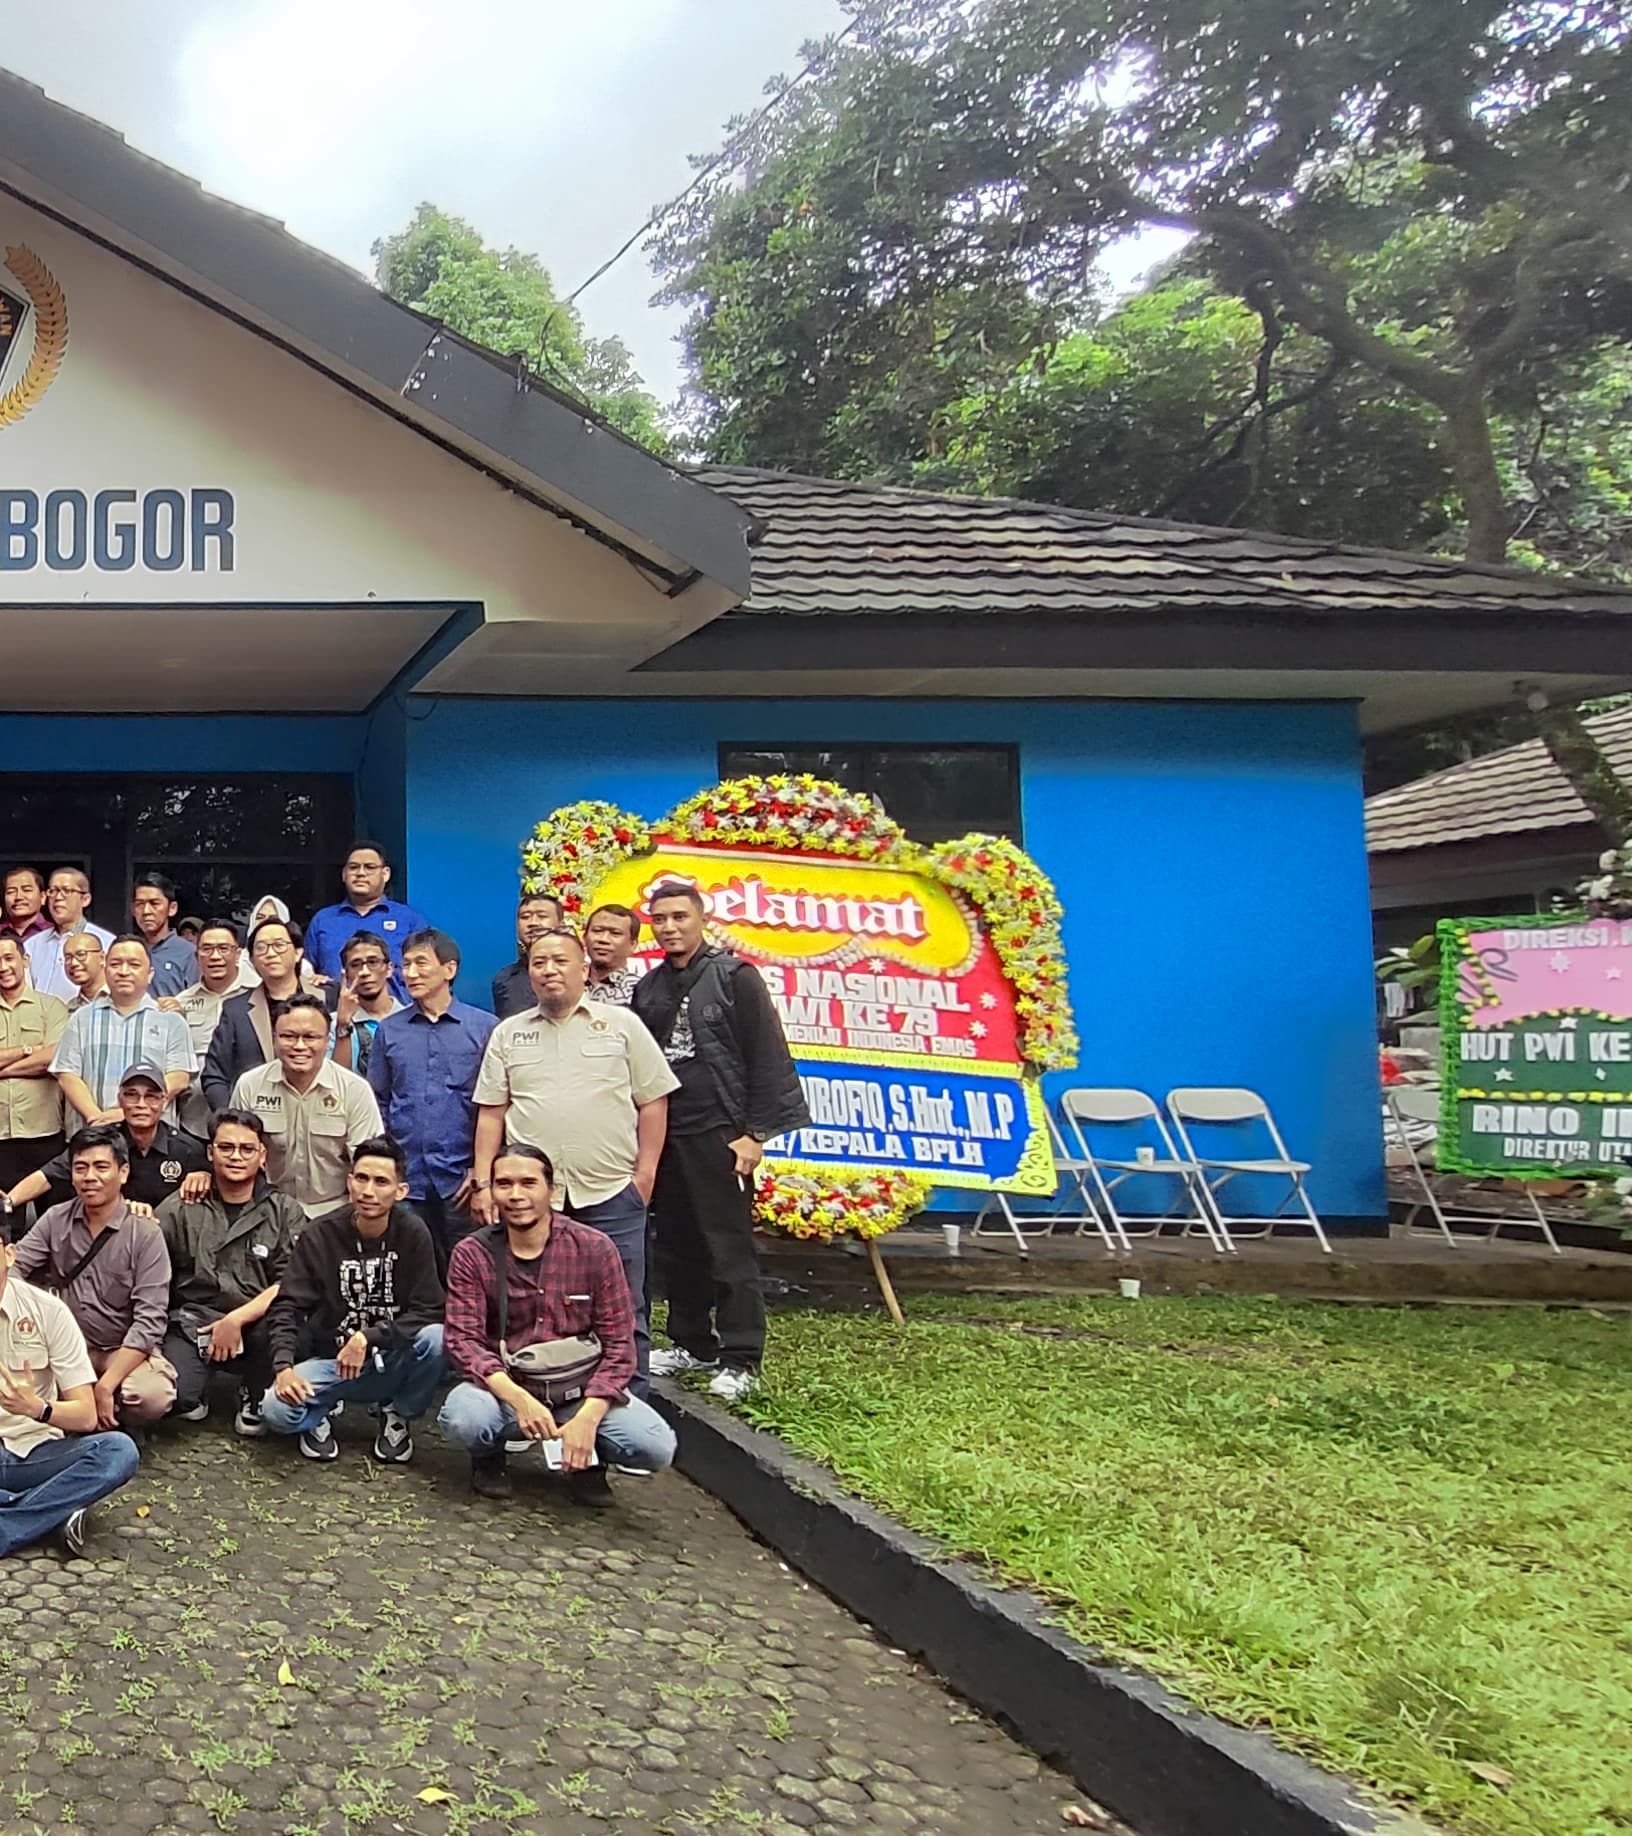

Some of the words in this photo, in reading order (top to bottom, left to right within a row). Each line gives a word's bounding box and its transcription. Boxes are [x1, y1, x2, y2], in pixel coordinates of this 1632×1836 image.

[1504, 928, 1609, 951] DIREKSI
[795, 968, 971, 1012] NASIONAL
[776, 996, 838, 1027] WI
[842, 1001, 892, 1032] KE
[892, 1006, 939, 1035] 79
[512, 1031, 540, 1041] PWI
[846, 1029, 927, 1053] INDONESIA
[930, 1036, 977, 1057] EMAS
[1460, 1032, 1514, 1062] HUT
[1524, 1032, 1576, 1062] PWI
[1588, 1032, 1631, 1062] KE
[256, 1095, 282, 1107] PWI
[1472, 1104, 1580, 1136] RINO
[913, 1137, 984, 1166] BPLH
[1503, 1138, 1591, 1161] DIREKTUR
